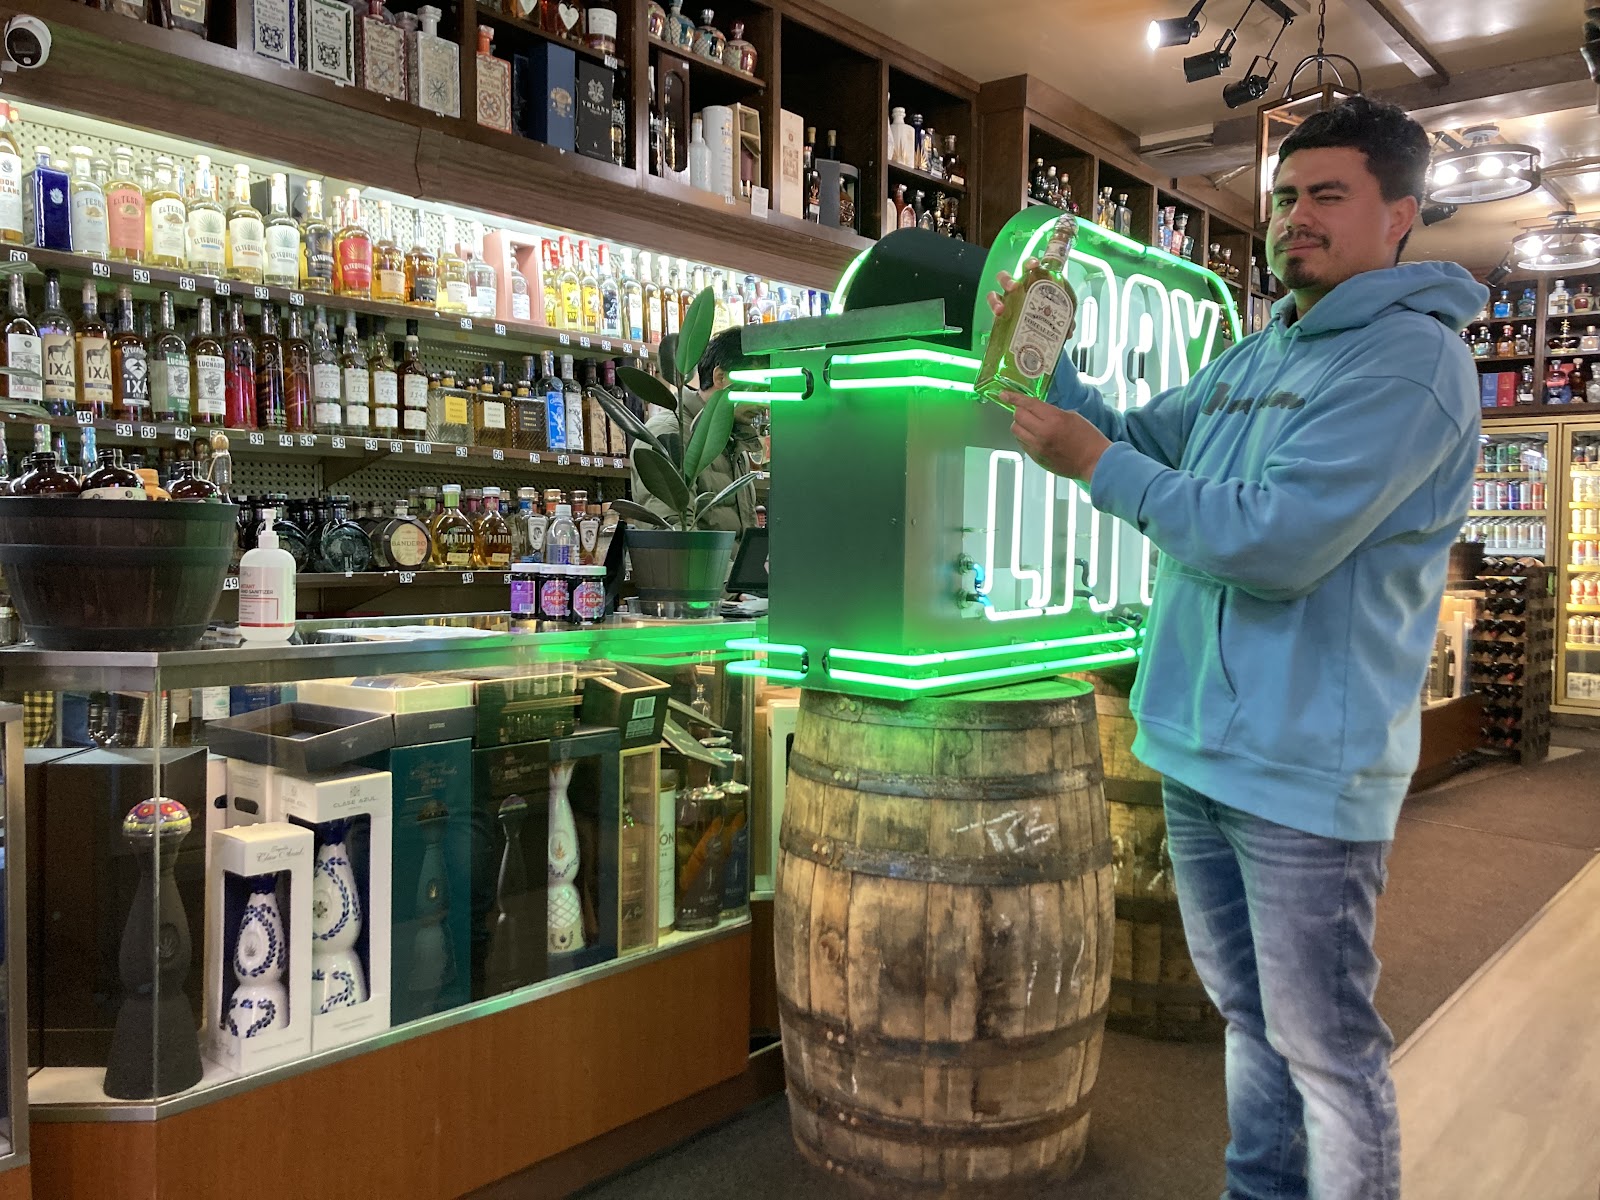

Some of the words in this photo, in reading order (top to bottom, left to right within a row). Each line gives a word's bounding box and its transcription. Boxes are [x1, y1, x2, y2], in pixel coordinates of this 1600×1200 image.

[94, 264, 109, 276] 49
[134, 270, 149, 281] 59
[181, 278, 195, 289] 69
[216, 283, 230, 295] 49
[255, 287, 269, 298] 59
[290, 294, 304, 305] 59
[461, 319, 472, 329] 59
[560, 334, 569, 344] 39
[602, 341, 611, 351] 59
[49, 361, 73, 378] IXÁ
[88, 365, 111, 381] IXÁ
[126, 377, 148, 395] IXÁ
[78, 411, 92, 423] 49
[117, 424, 132, 436] 59
[142, 427, 156, 439] 69
[176, 428, 190, 439] 49
[250, 432, 264, 444] 39
[279, 435, 293, 446] 49
[300, 435, 314, 446] 59
[332, 437, 345, 449] 59
[365, 439, 378, 450] 59
[390, 442, 403, 453] 69
[415, 443, 431, 454] 100
[456, 446, 467, 457] 59
[493, 450, 504, 460] 69
[529, 453, 540, 463] 79
[581, 457, 590, 467] 39
[594, 458, 603, 467] 49
[613, 459, 623, 468] 59
[400, 572, 412, 583] 39
[463, 573, 473, 583] 49
[225, 578, 239, 589] 49
[333, 799, 356, 809] CLASE
[358, 796, 378, 804] AZUL
